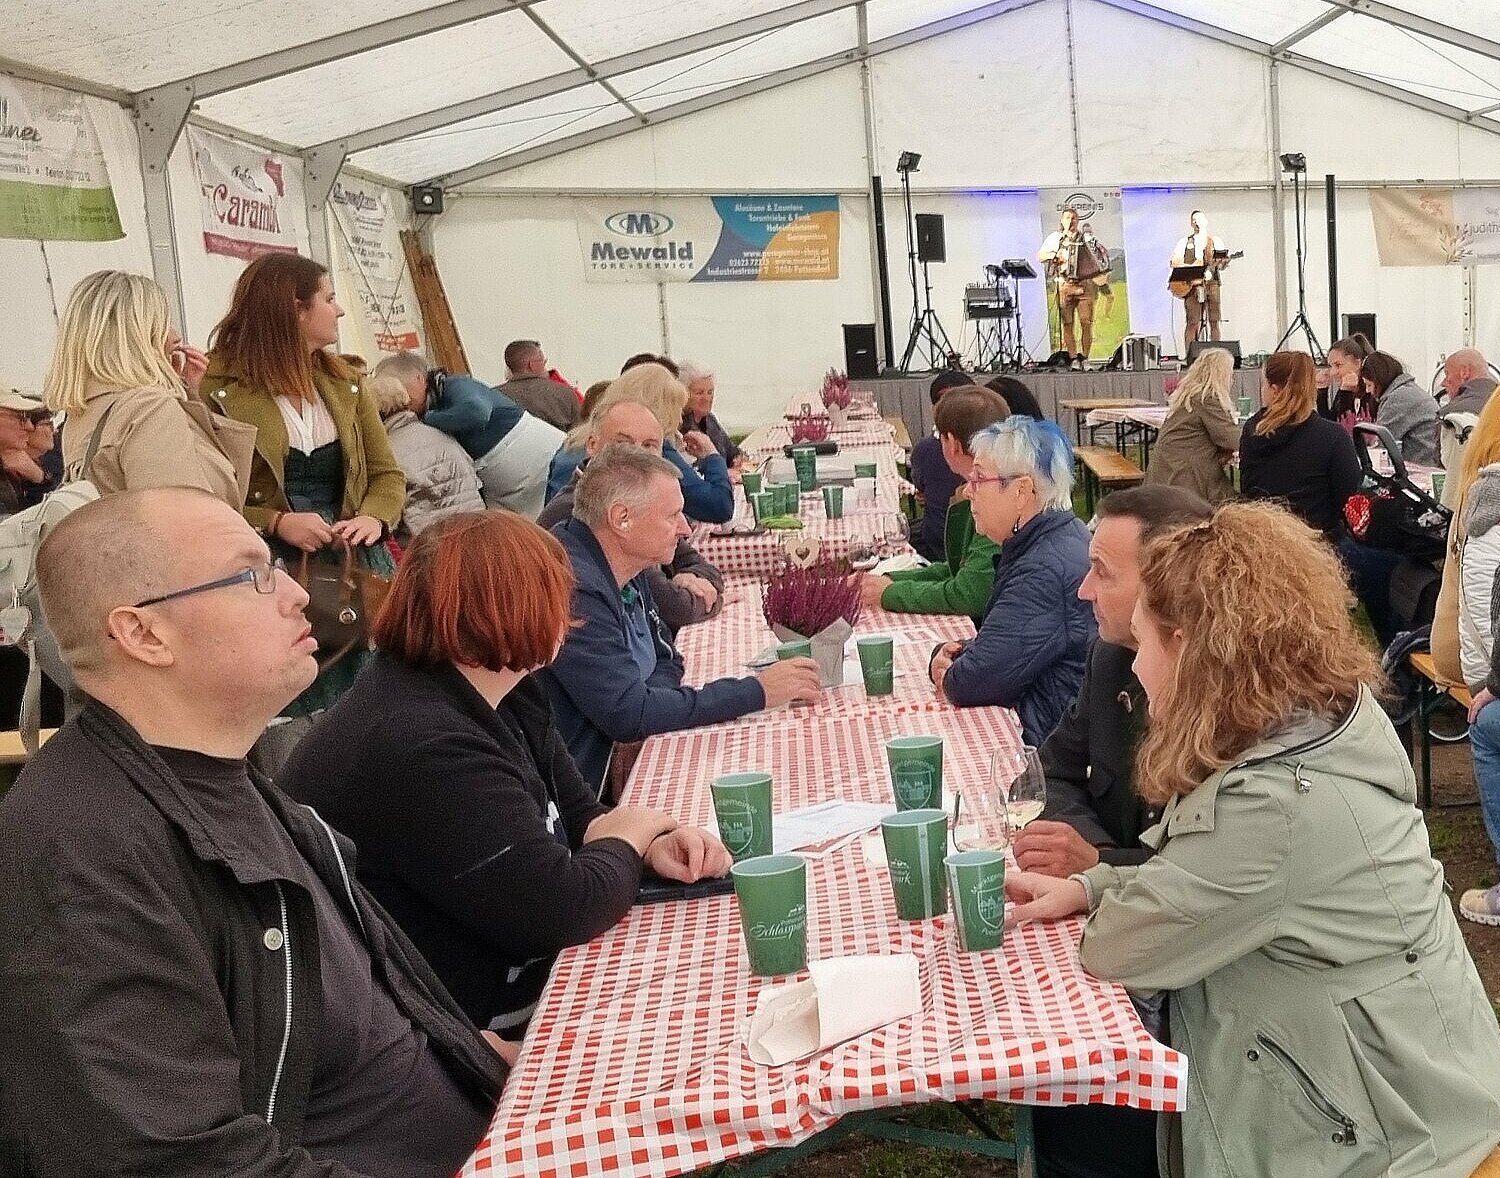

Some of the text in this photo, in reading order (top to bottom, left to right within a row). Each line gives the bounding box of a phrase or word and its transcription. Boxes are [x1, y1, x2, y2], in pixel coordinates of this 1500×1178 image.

[626, 213, 654, 234] M
[591, 241, 694, 260] Mewald
[593, 262, 626, 270] TORE
[638, 262, 694, 270] SERVICE
